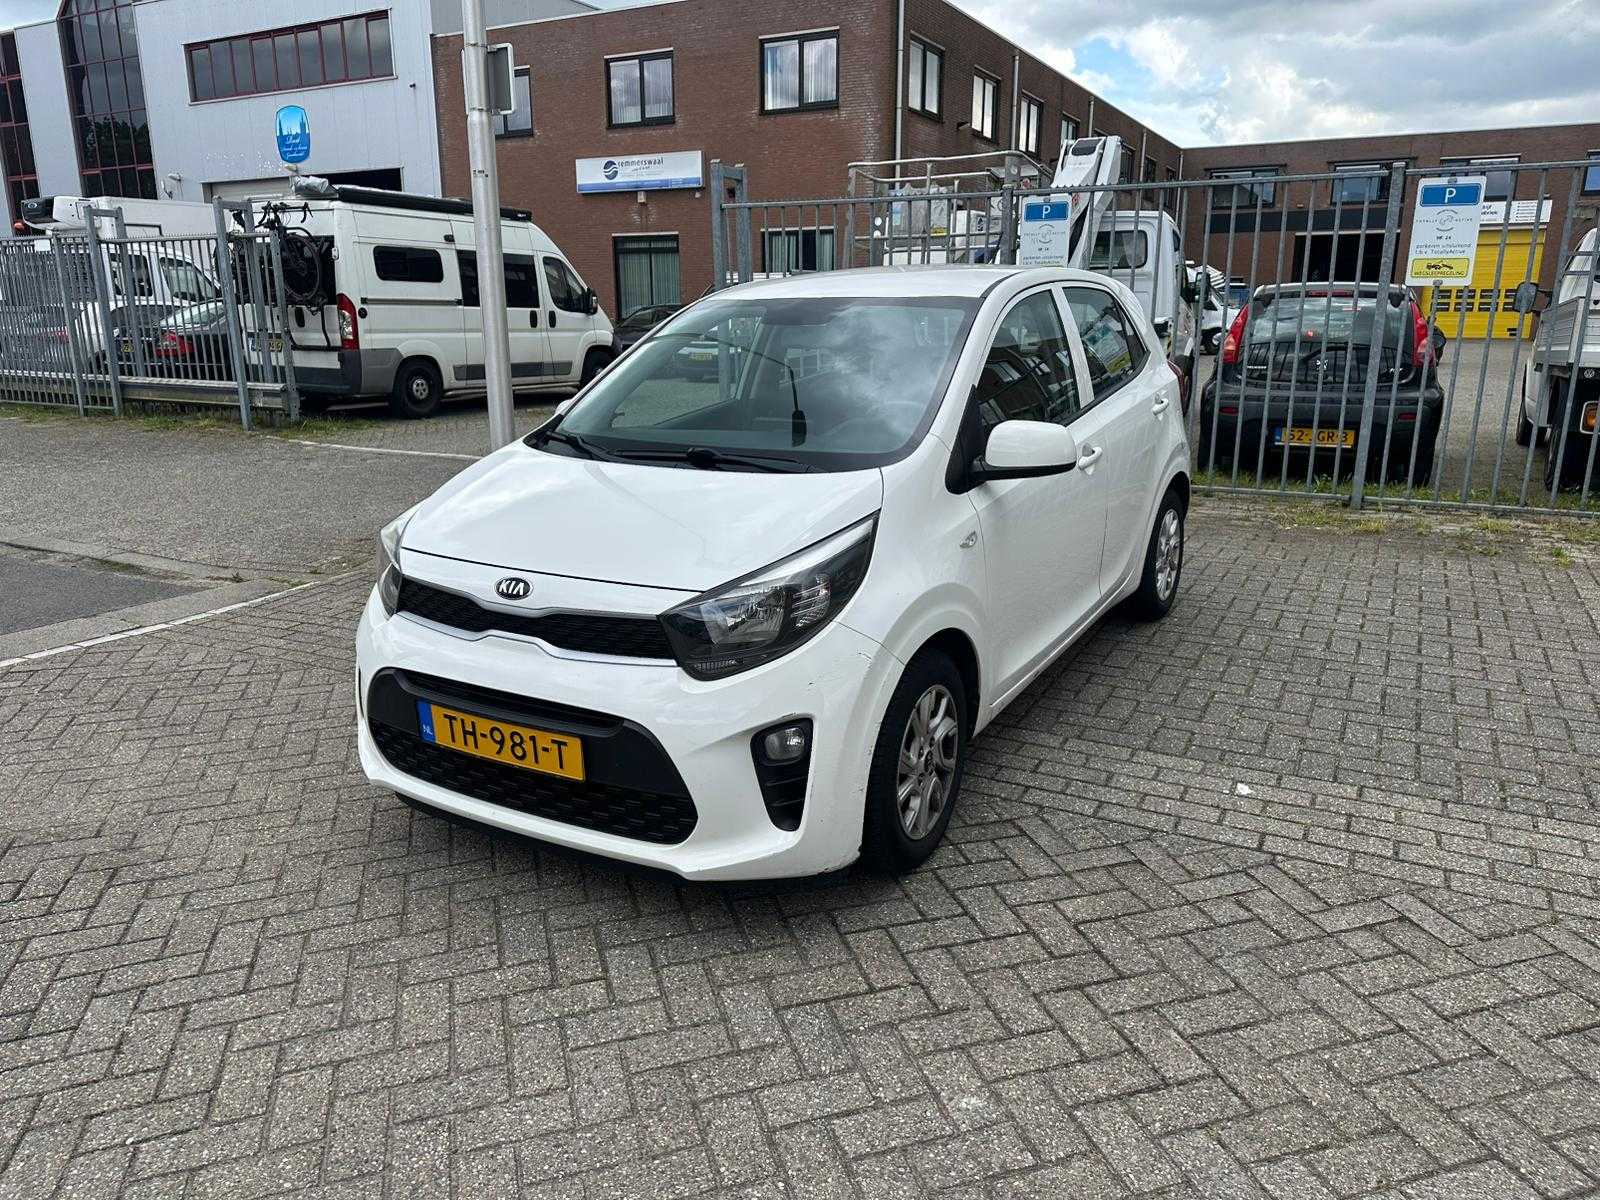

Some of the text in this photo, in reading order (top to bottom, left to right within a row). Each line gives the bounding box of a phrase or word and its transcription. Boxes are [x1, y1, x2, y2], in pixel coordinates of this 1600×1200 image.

[1444, 187, 1457, 204] P
[1042, 205, 1051, 219] P
[499, 579, 525, 596] KIA
[443, 713, 568, 770] TH-981-T
